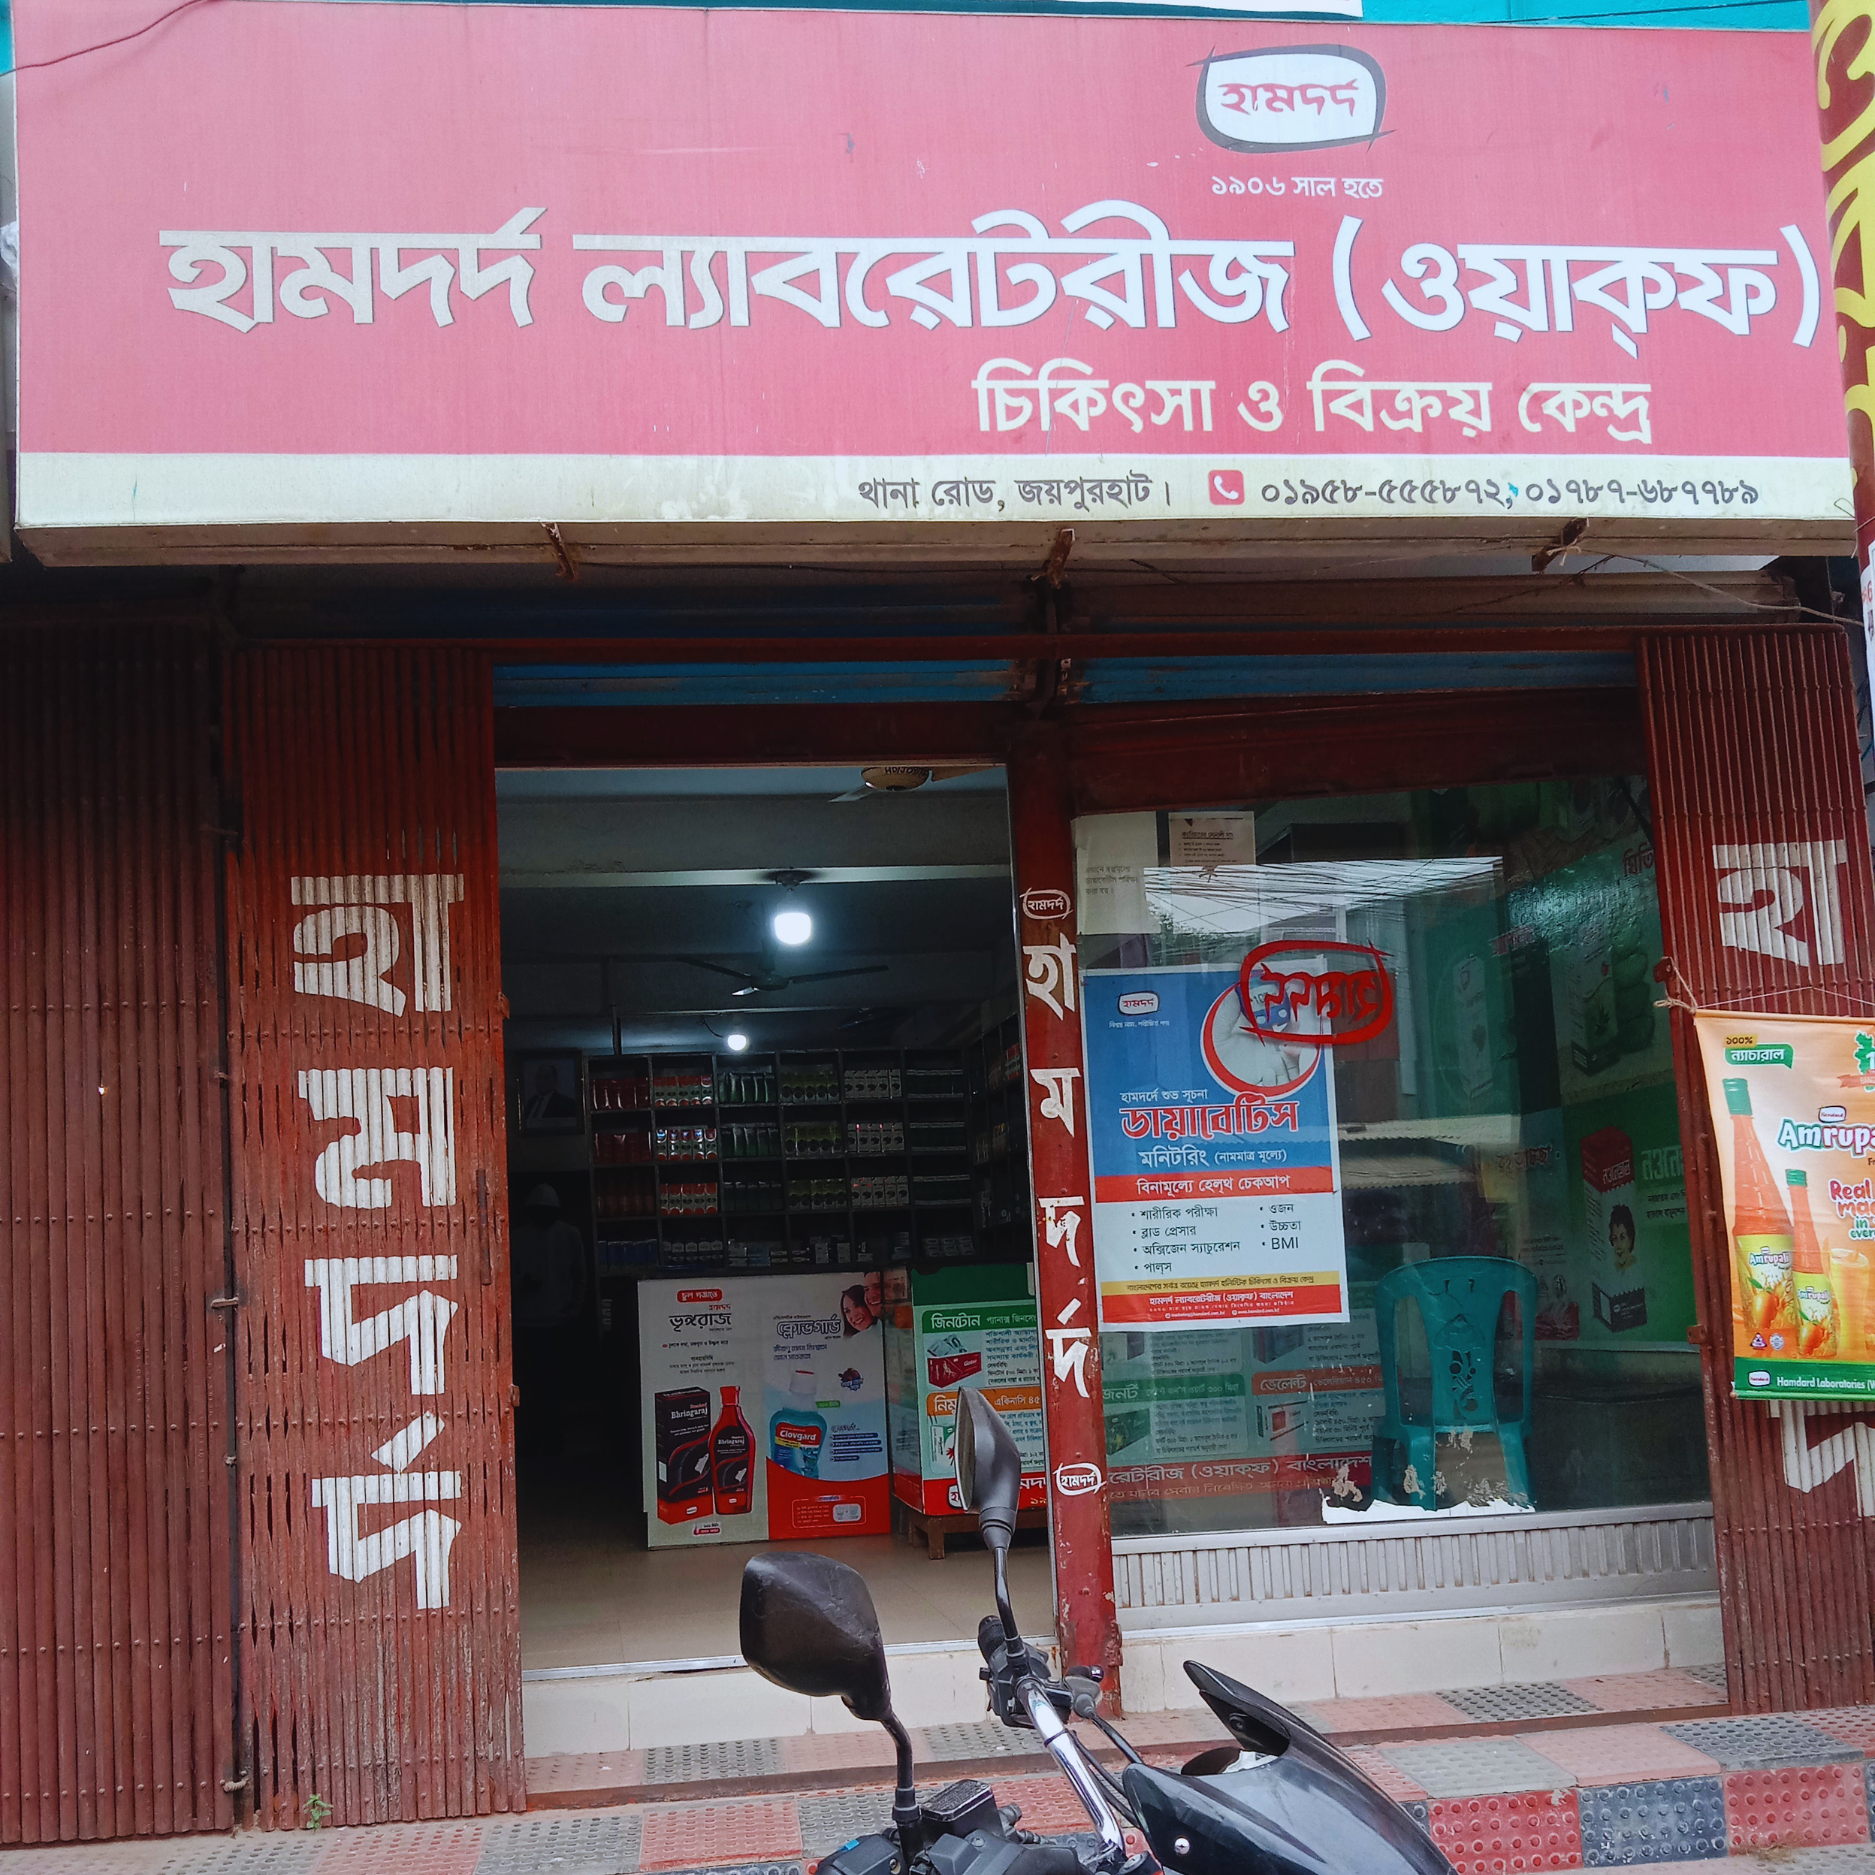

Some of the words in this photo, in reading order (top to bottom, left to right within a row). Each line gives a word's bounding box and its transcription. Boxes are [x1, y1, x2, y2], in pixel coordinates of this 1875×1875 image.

[1217, 78, 1359, 117] হামদর্দ
[1211, 176, 1286, 196] ১৯০৬
[1291, 176, 1337, 197] সাল
[1341, 178, 1385, 199] হতে
[159, 207, 548, 334] হামদর্দ
[572, 200, 1296, 334] ল্যাবরেটরীজ
[970, 357, 1216, 434] চিকিৎসা
[1237, 380, 1284, 432] ও
[1306, 359, 1493, 438] বিক্রয়
[1517, 382, 1653, 444] কেন্দ্র
[857, 477, 920, 509] থানা
[931, 476, 1006, 512] রোড,
[1014, 472, 1152, 513] জয়পুরহাট
[1726, 1035, 1753, 1045] ১০০%
[1730, 1048, 1785, 1062] ন্যাচারাল
[1120, 1087, 1159, 1104] হামদর্দে
[1182, 1088, 1208, 1104] সূচনা
[1119, 1091, 1300, 1140] ডায়াবেটিস
[1138, 1144, 1210, 1169] মনিটরিং
[1136, 1177, 1194, 1198] বিনামূল্যে
[1238, 1174, 1291, 1191] চেকআপ
[1829, 1179, 1873, 1201] Real
[1139, 1206, 1182, 1221] শারীরিক
[1185, 1204, 1218, 1218] পরীক্ষা
[1268, 1203, 1294, 1214] ওজন
[1165, 1225, 1197, 1237] প্রেসার
[1269, 1220, 1302, 1232] উচ্চতা
[1855, 1216, 1868, 1229] in
[1142, 1241, 1187, 1256] অক্সিজেন
[1191, 1240, 1241, 1256] স্যাচুরেশন
[1271, 1236, 1299, 1250] BMI
[1749, 1252, 1790, 1266] Amrupali
[930, 1313, 981, 1330] জিনটোন
[1260, 1373, 1308, 1391] ভেলেন্ট
[1776, 1376, 1816, 1388] Hamdard
[1816, 1376, 1866, 1390] Laboratories
[671, 1406, 708, 1420] Bhringaraj
[779, 1429, 817, 1442] Clovgard
[1060, 1471, 1095, 1488] হামদর্দ
